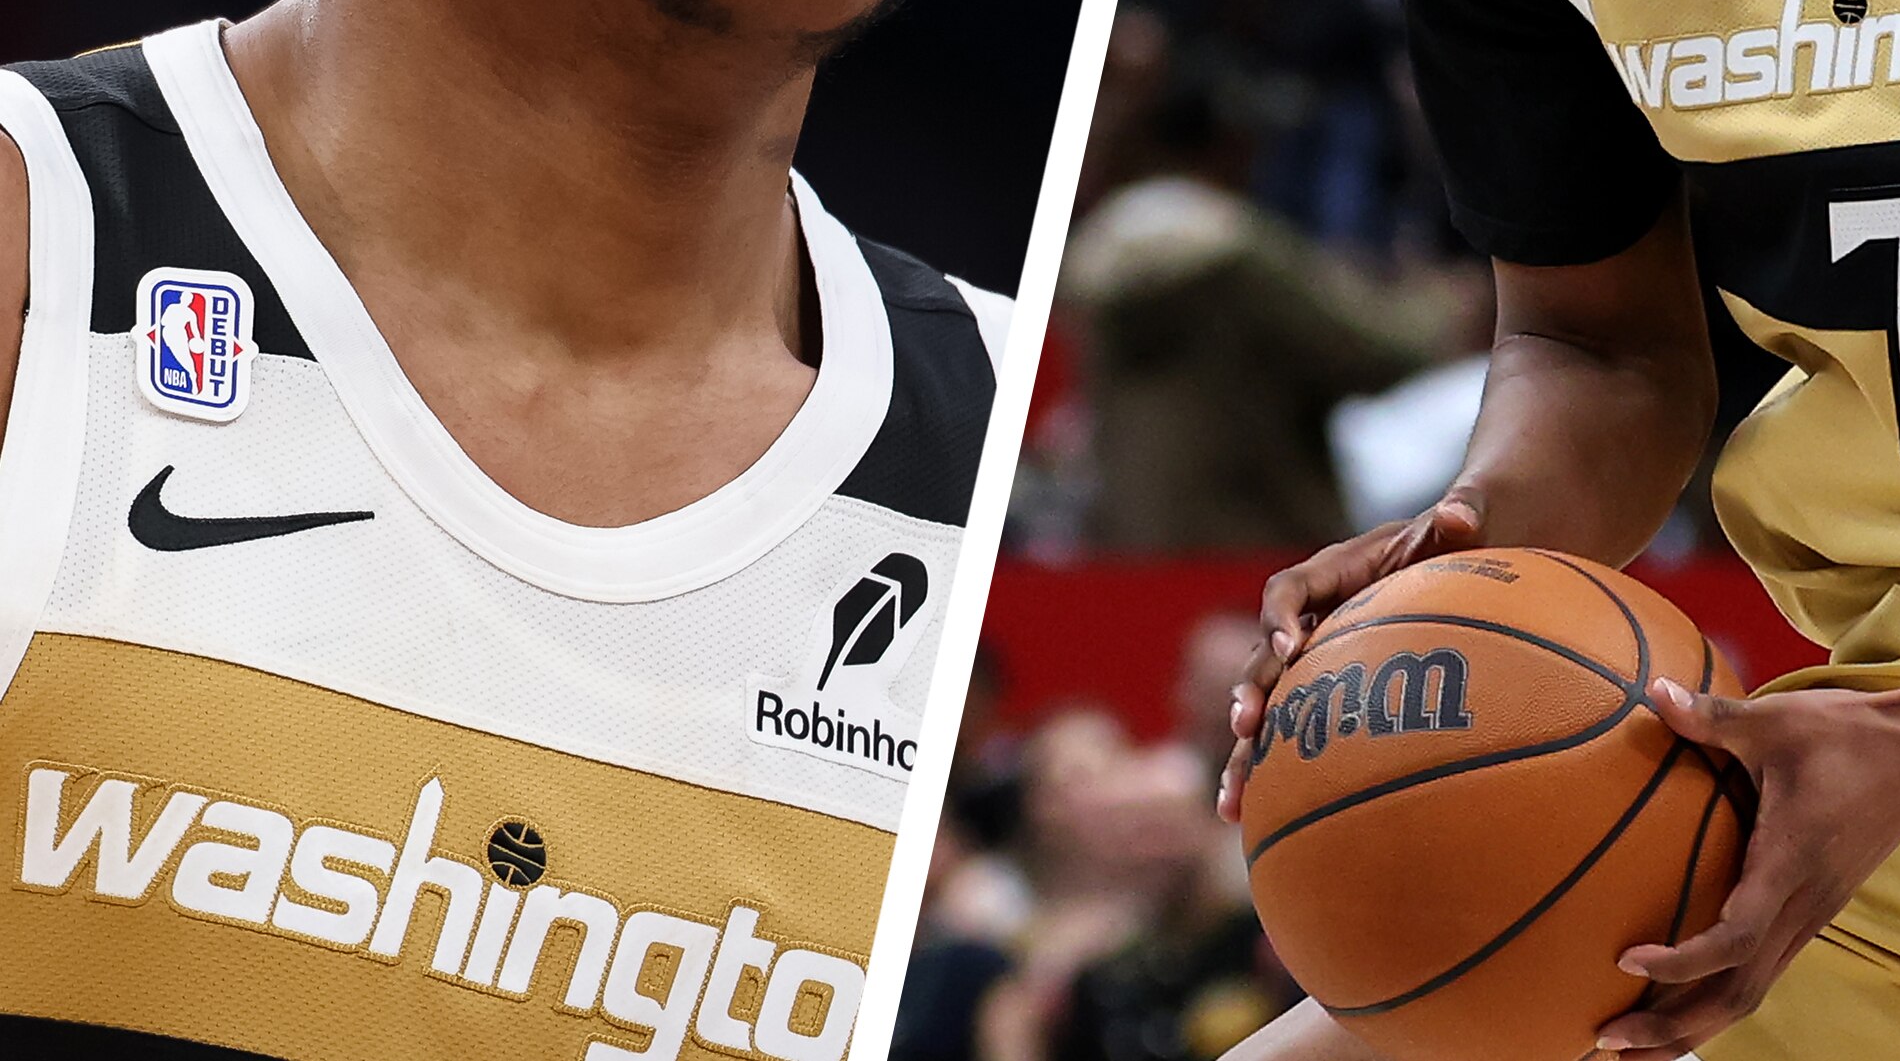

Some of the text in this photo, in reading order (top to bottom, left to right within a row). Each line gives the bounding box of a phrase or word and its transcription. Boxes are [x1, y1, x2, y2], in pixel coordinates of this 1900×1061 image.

[163, 367, 188, 389] NBA
[209, 296, 229, 397] DEBUT
[1250, 647, 1473, 768] Wilso
